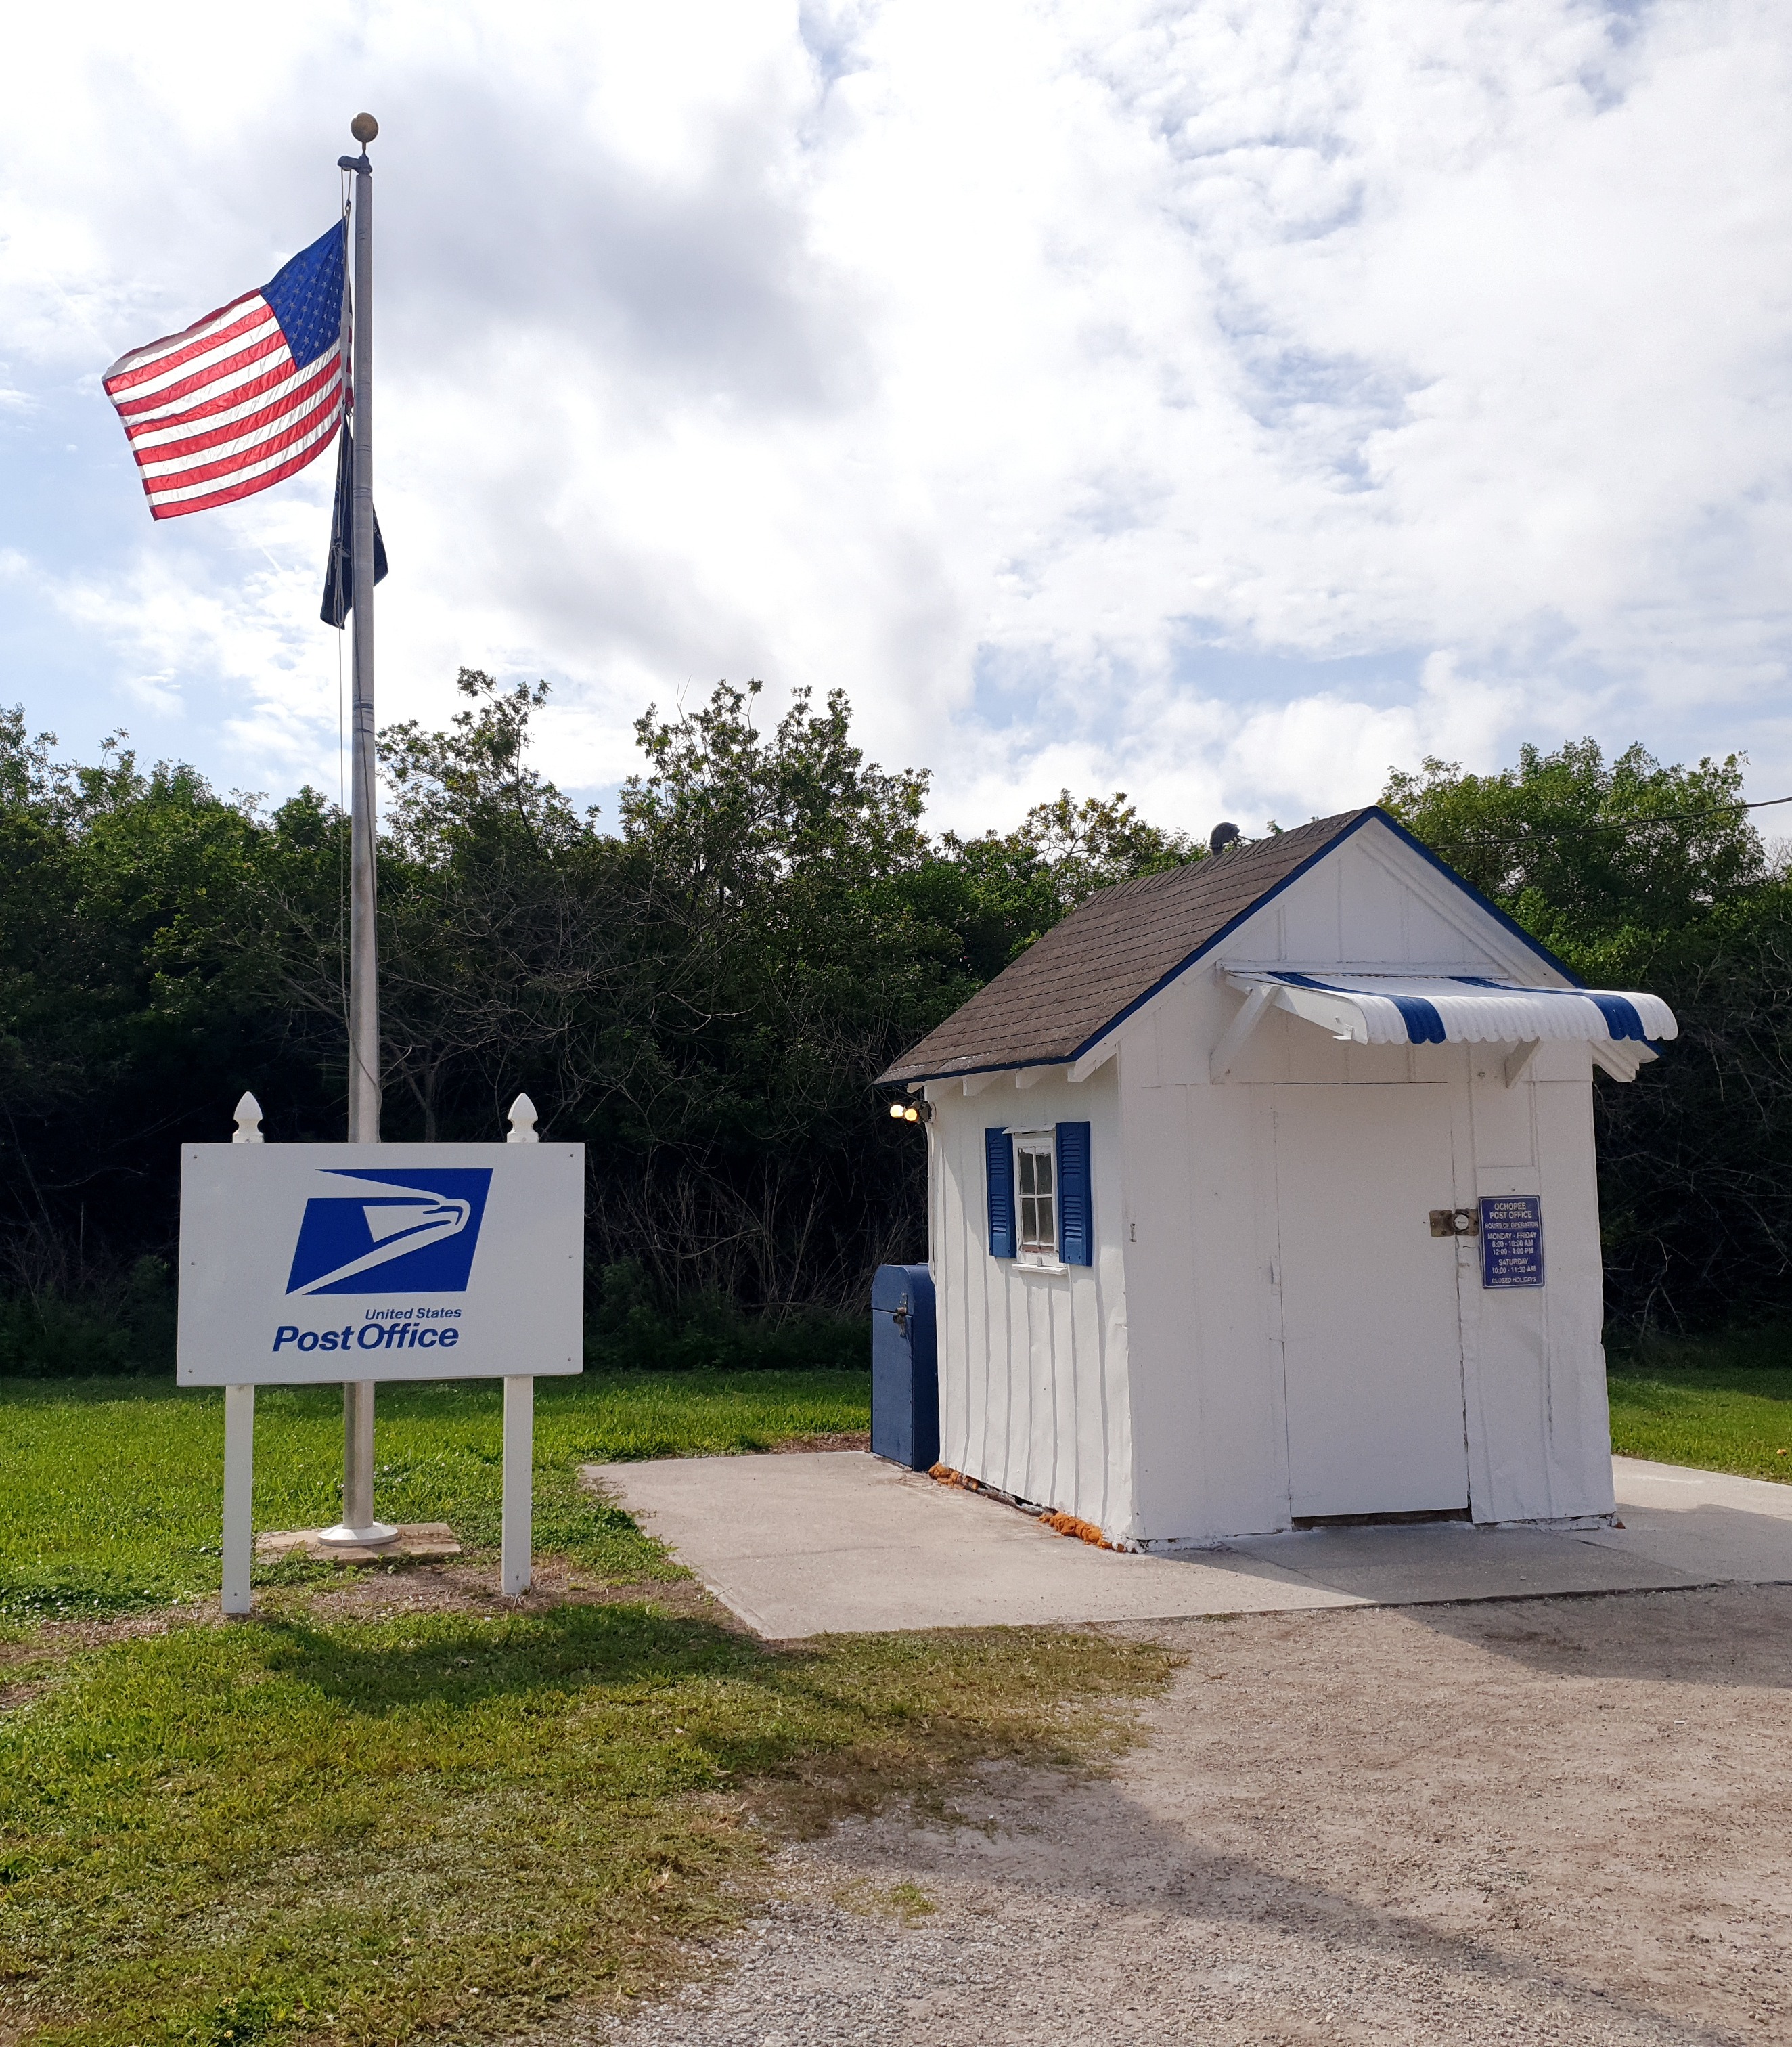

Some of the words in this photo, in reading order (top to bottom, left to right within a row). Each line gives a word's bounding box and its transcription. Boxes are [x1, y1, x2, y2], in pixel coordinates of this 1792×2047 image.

[1494, 1202, 1527, 1210] OCHOPEE
[365, 1308, 413, 1320] United
[416, 1307, 462, 1319] States
[272, 1325, 355, 1352] Post
[357, 1322, 460, 1350] Office
